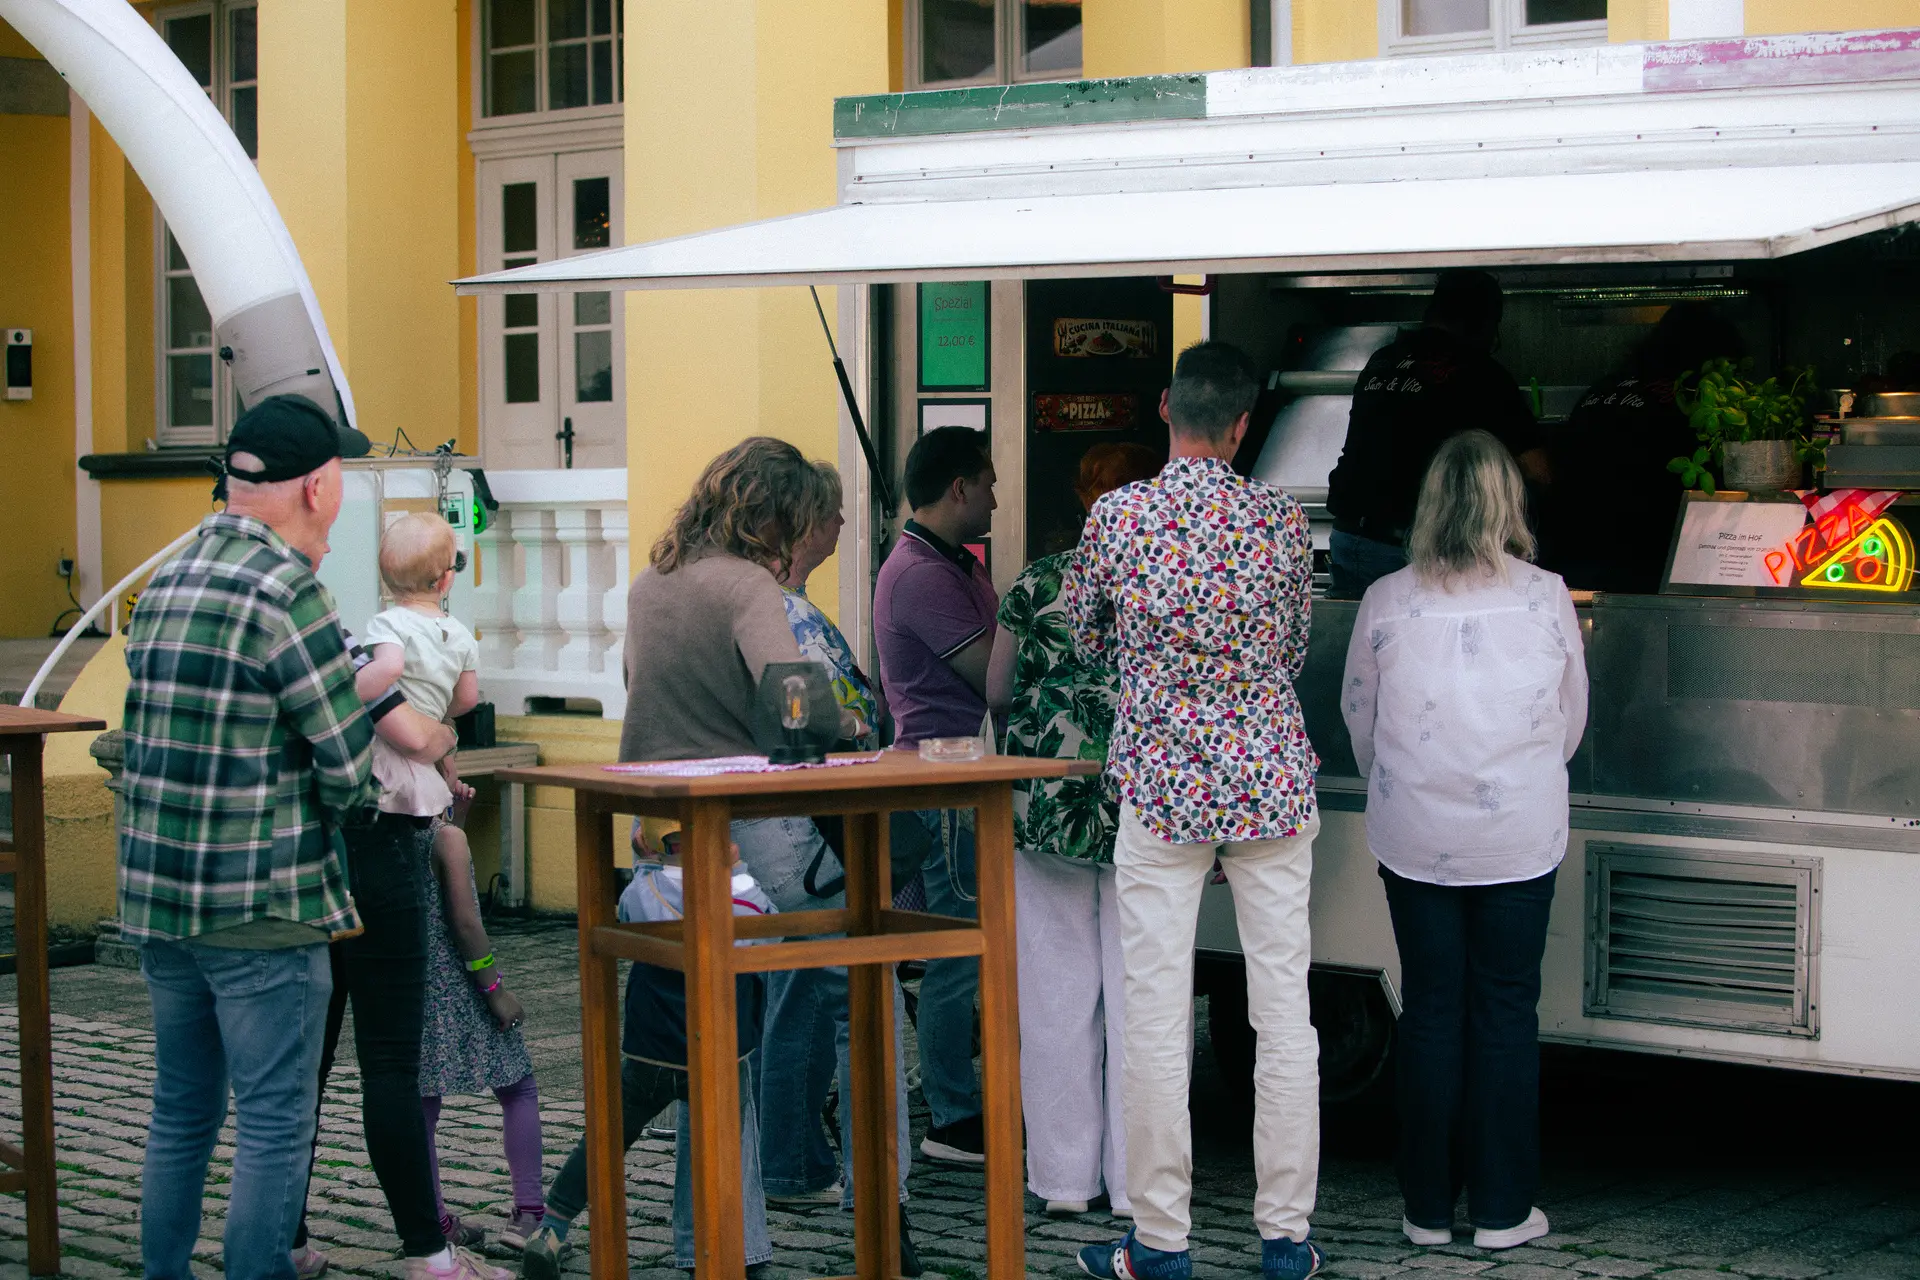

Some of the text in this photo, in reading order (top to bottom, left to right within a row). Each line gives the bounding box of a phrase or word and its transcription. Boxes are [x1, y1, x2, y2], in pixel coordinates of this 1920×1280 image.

[934, 296, 972, 312] Spezial
[1068, 321, 1140, 338] CUCINA ITALIANA
[937, 335, 976, 348] 12,00 €
[1387, 377, 1398, 391] &
[1401, 378, 1422, 392] Vito
[1619, 392, 1645, 407] Vito
[1069, 401, 1106, 420] PIZZA
[1718, 532, 1763, 542] Pizza im Hof
[1764, 503, 1876, 584] PIZZA
